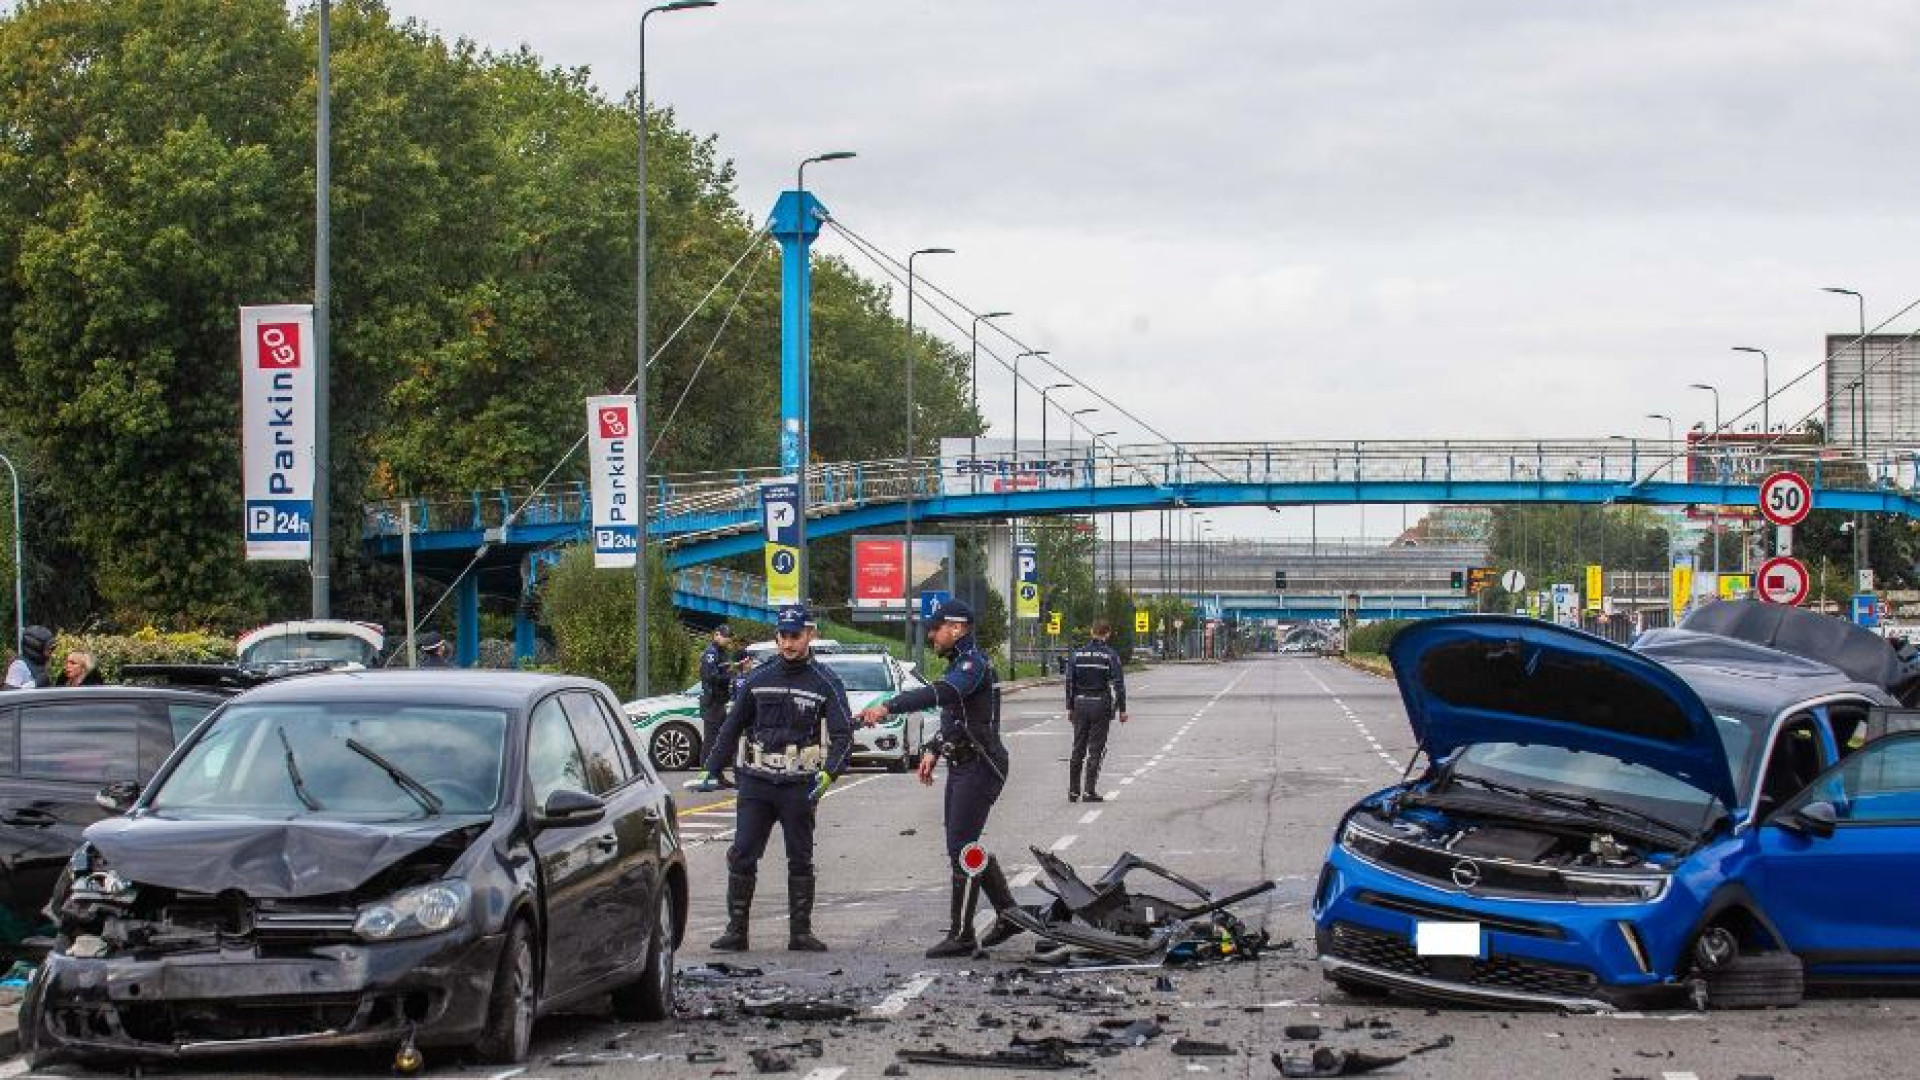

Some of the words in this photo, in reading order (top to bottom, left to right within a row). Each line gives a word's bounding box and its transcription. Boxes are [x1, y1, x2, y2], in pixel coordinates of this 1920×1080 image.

[1770, 487, 1800, 510] 50
[256, 510, 270, 530] P
[277, 511, 310, 534] 24h
[766, 501, 795, 541] P
[1018, 557, 1036, 580] P
